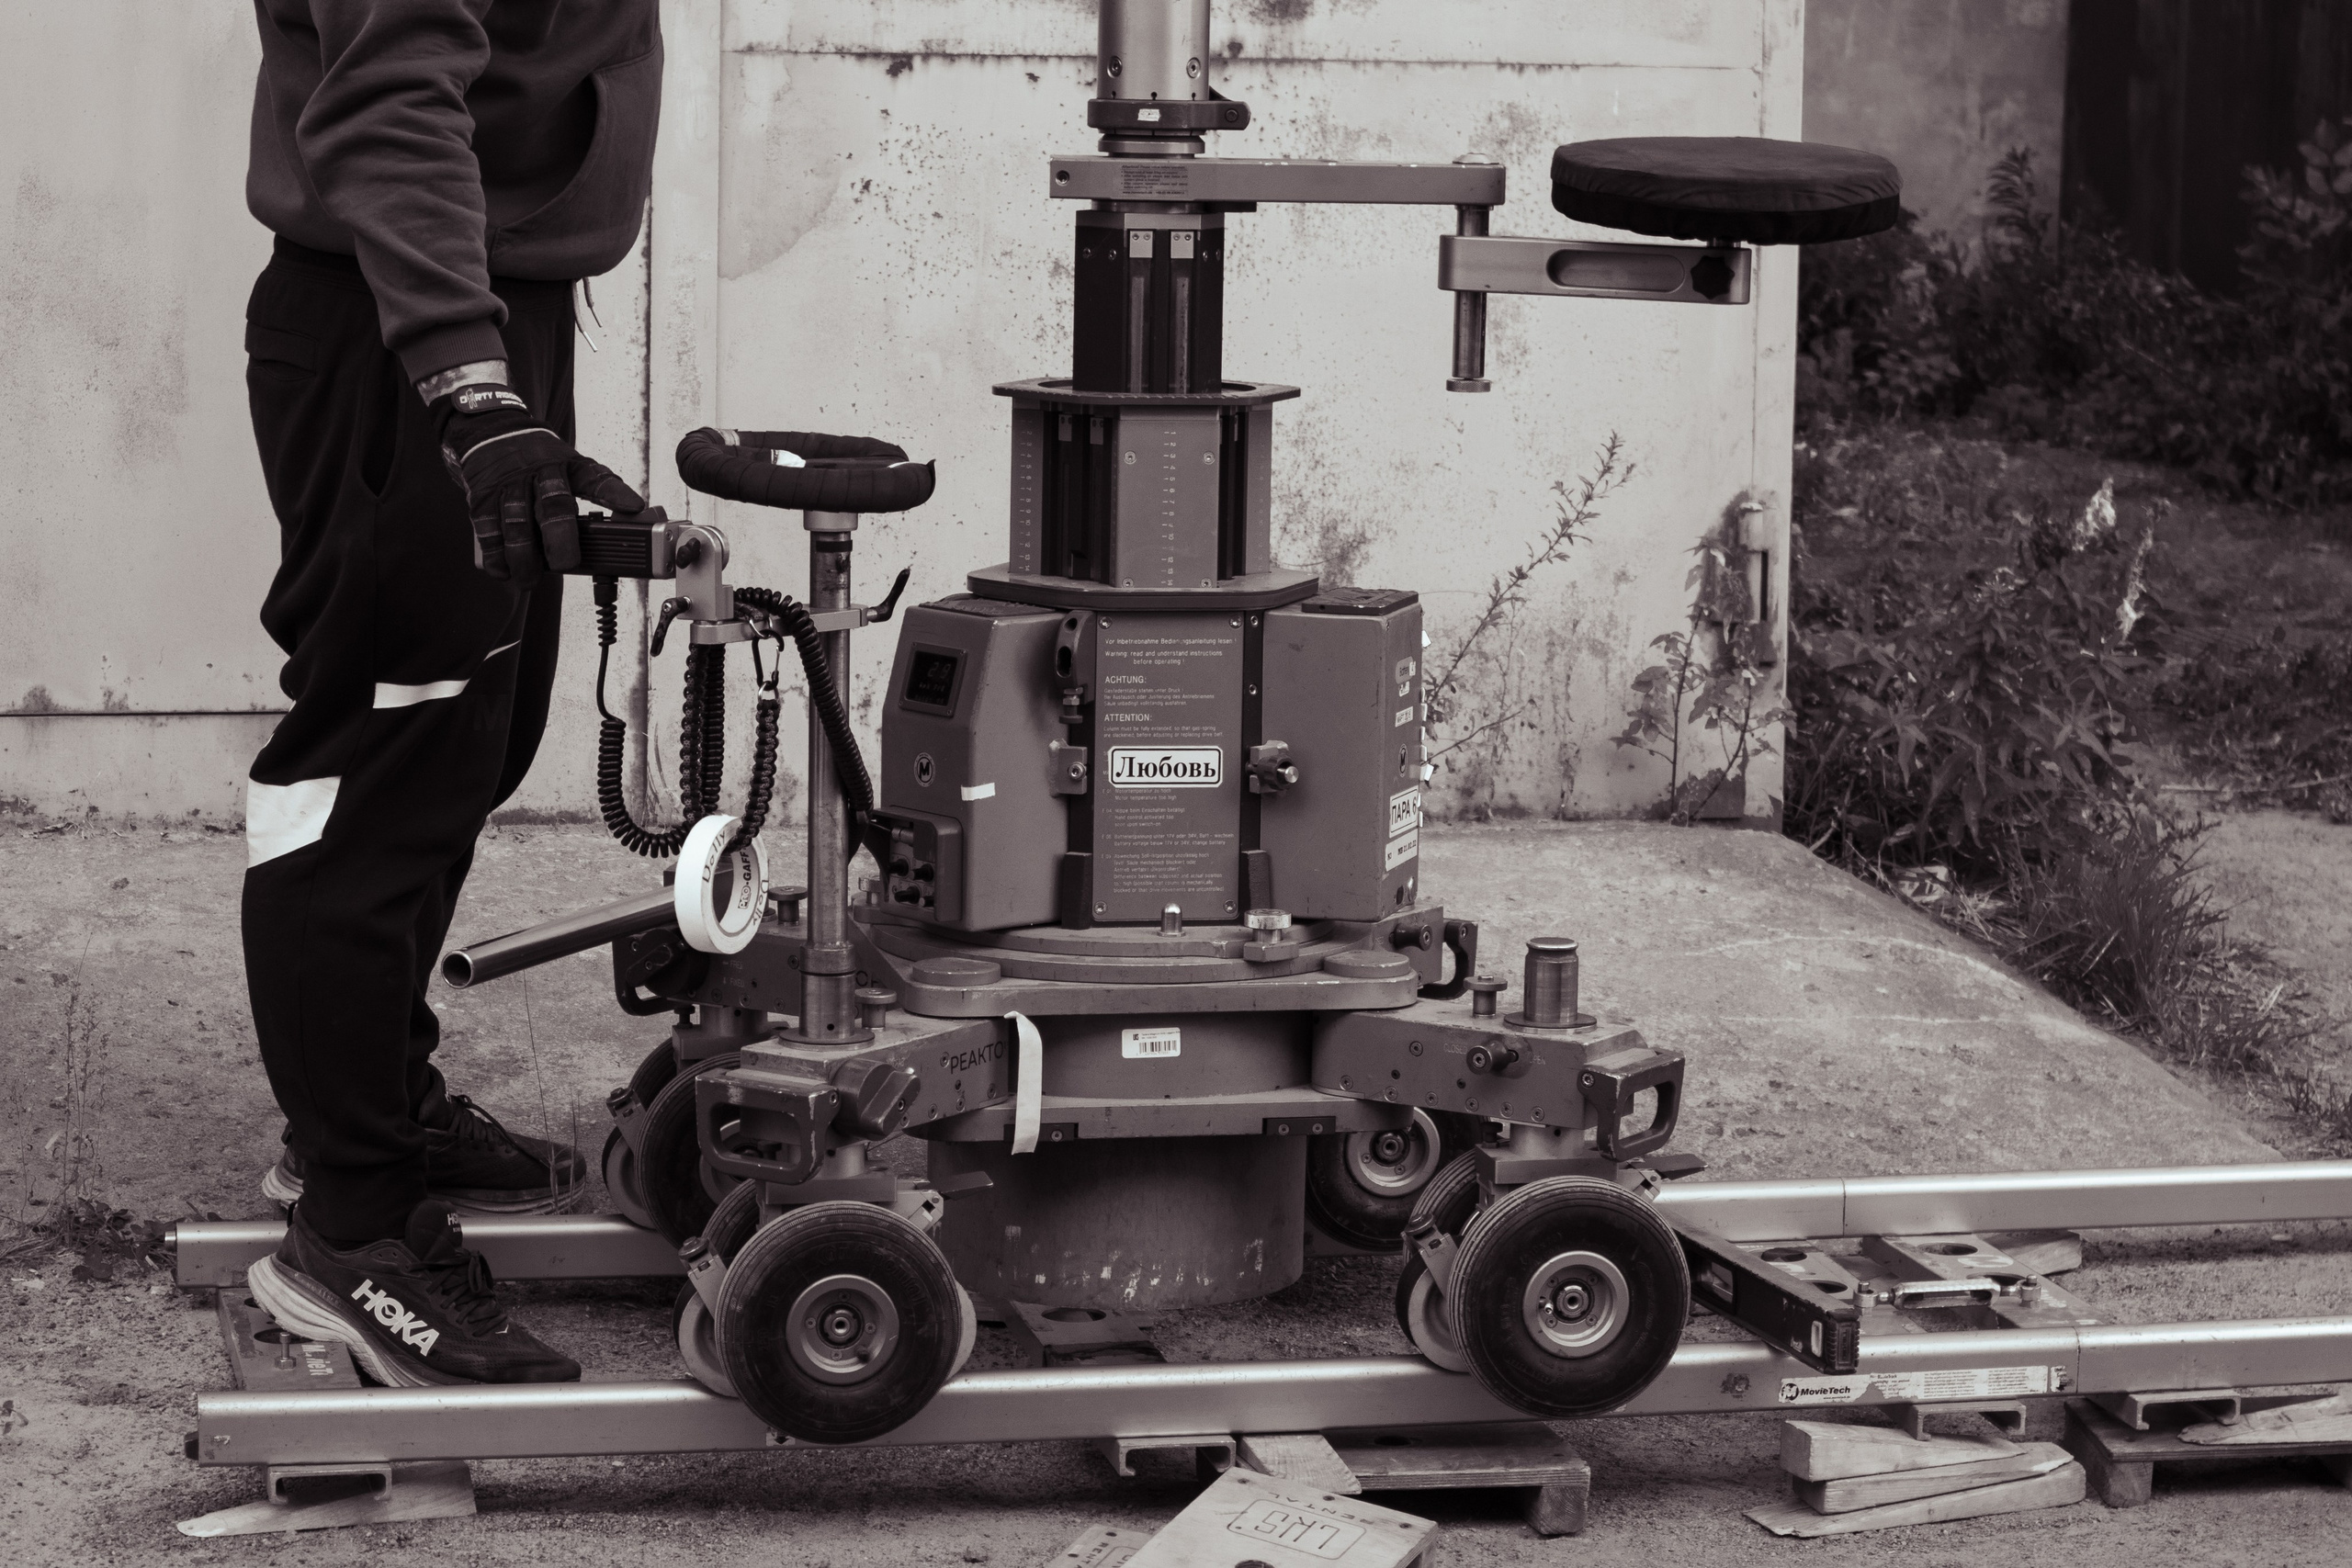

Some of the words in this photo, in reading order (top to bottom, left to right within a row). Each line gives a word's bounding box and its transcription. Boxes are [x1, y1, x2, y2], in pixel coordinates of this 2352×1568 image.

[1104, 675, 1148, 684] ACHTUNG:
[1103, 713, 1153, 722] ATTENTION:
[1115, 755, 1216, 778] Любовь
[1392, 799, 1411, 826] ПАРА
[1412, 796, 1417, 816] 6
[702, 829, 726, 884] Dolly
[950, 1040, 1007, 1075] РЕАКТО
[351, 1278, 440, 1357] HOKA
[1800, 1385, 1851, 1396] MovieTech
[1268, 1491, 1374, 1526] RENTAL
